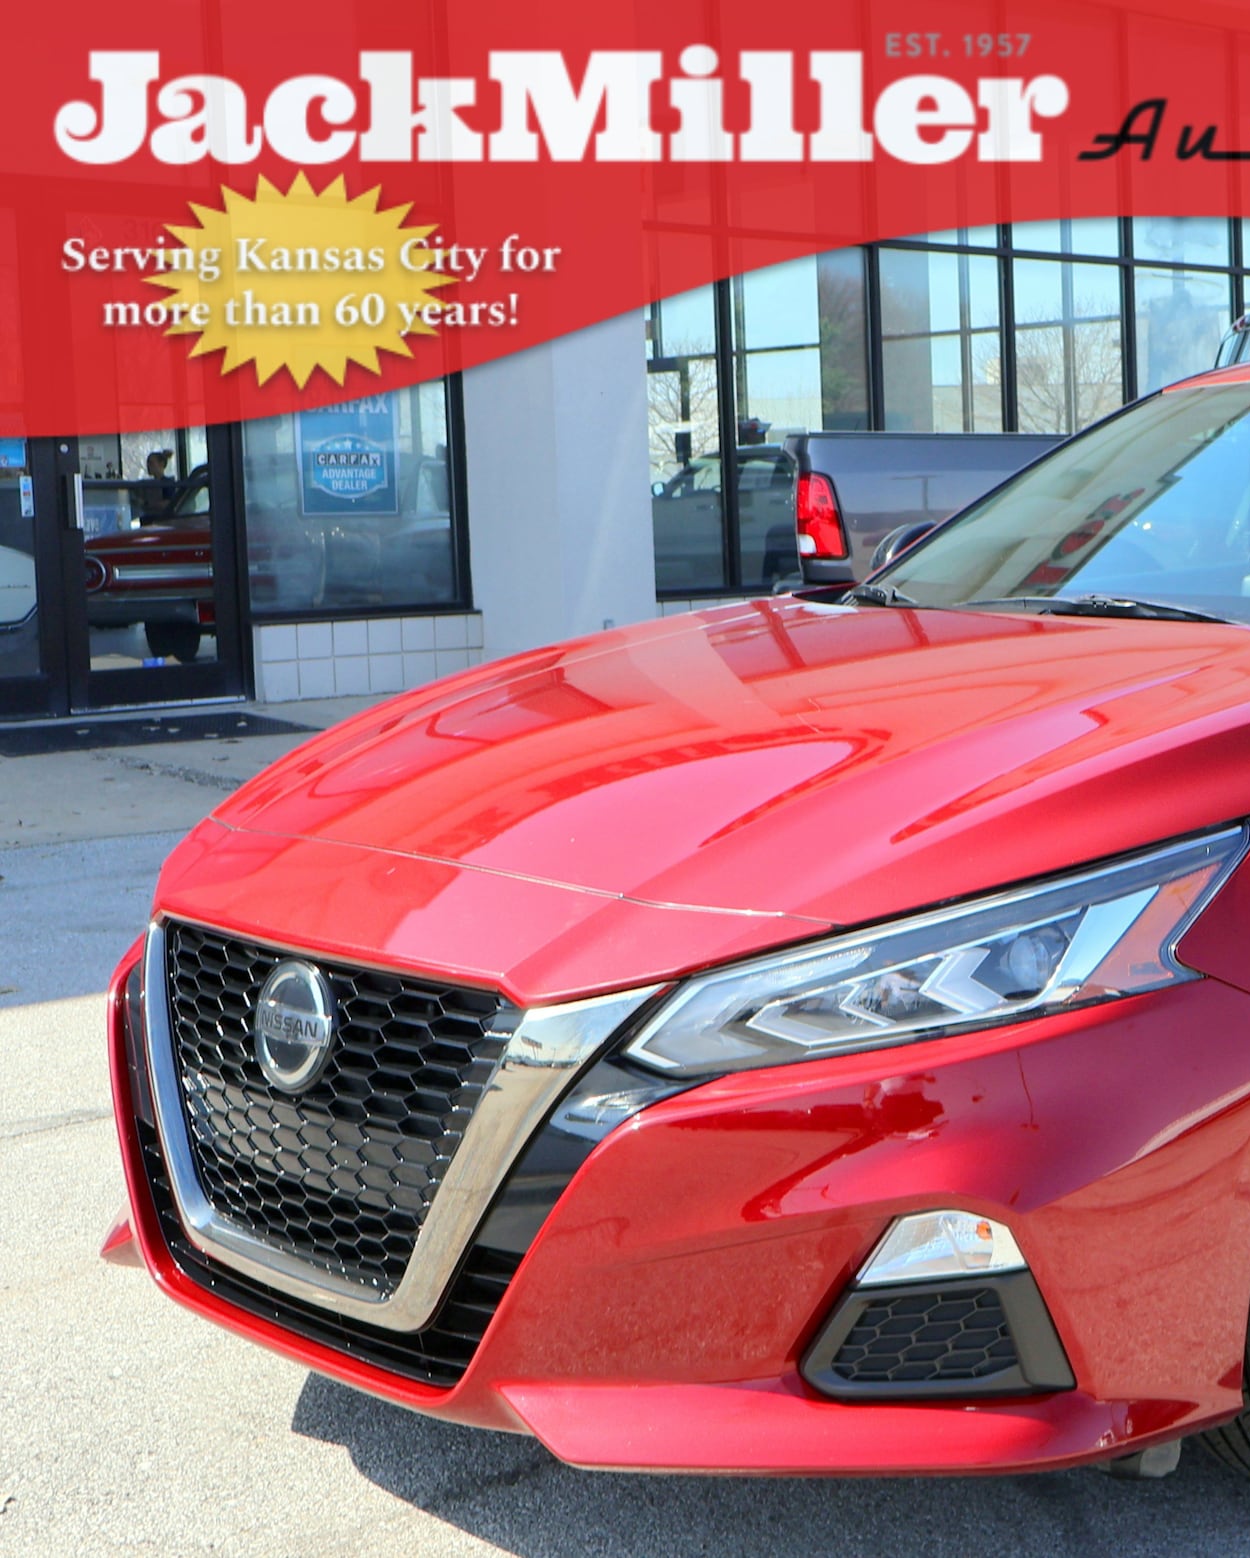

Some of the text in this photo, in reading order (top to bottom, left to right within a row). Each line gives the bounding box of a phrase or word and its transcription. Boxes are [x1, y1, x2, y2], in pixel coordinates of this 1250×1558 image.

[317, 454, 380, 465] CARFAX
[322, 468, 377, 479] ADVANTAGE
[331, 480, 368, 490] DEALER
[261, 1010, 318, 1038] NISSAN
